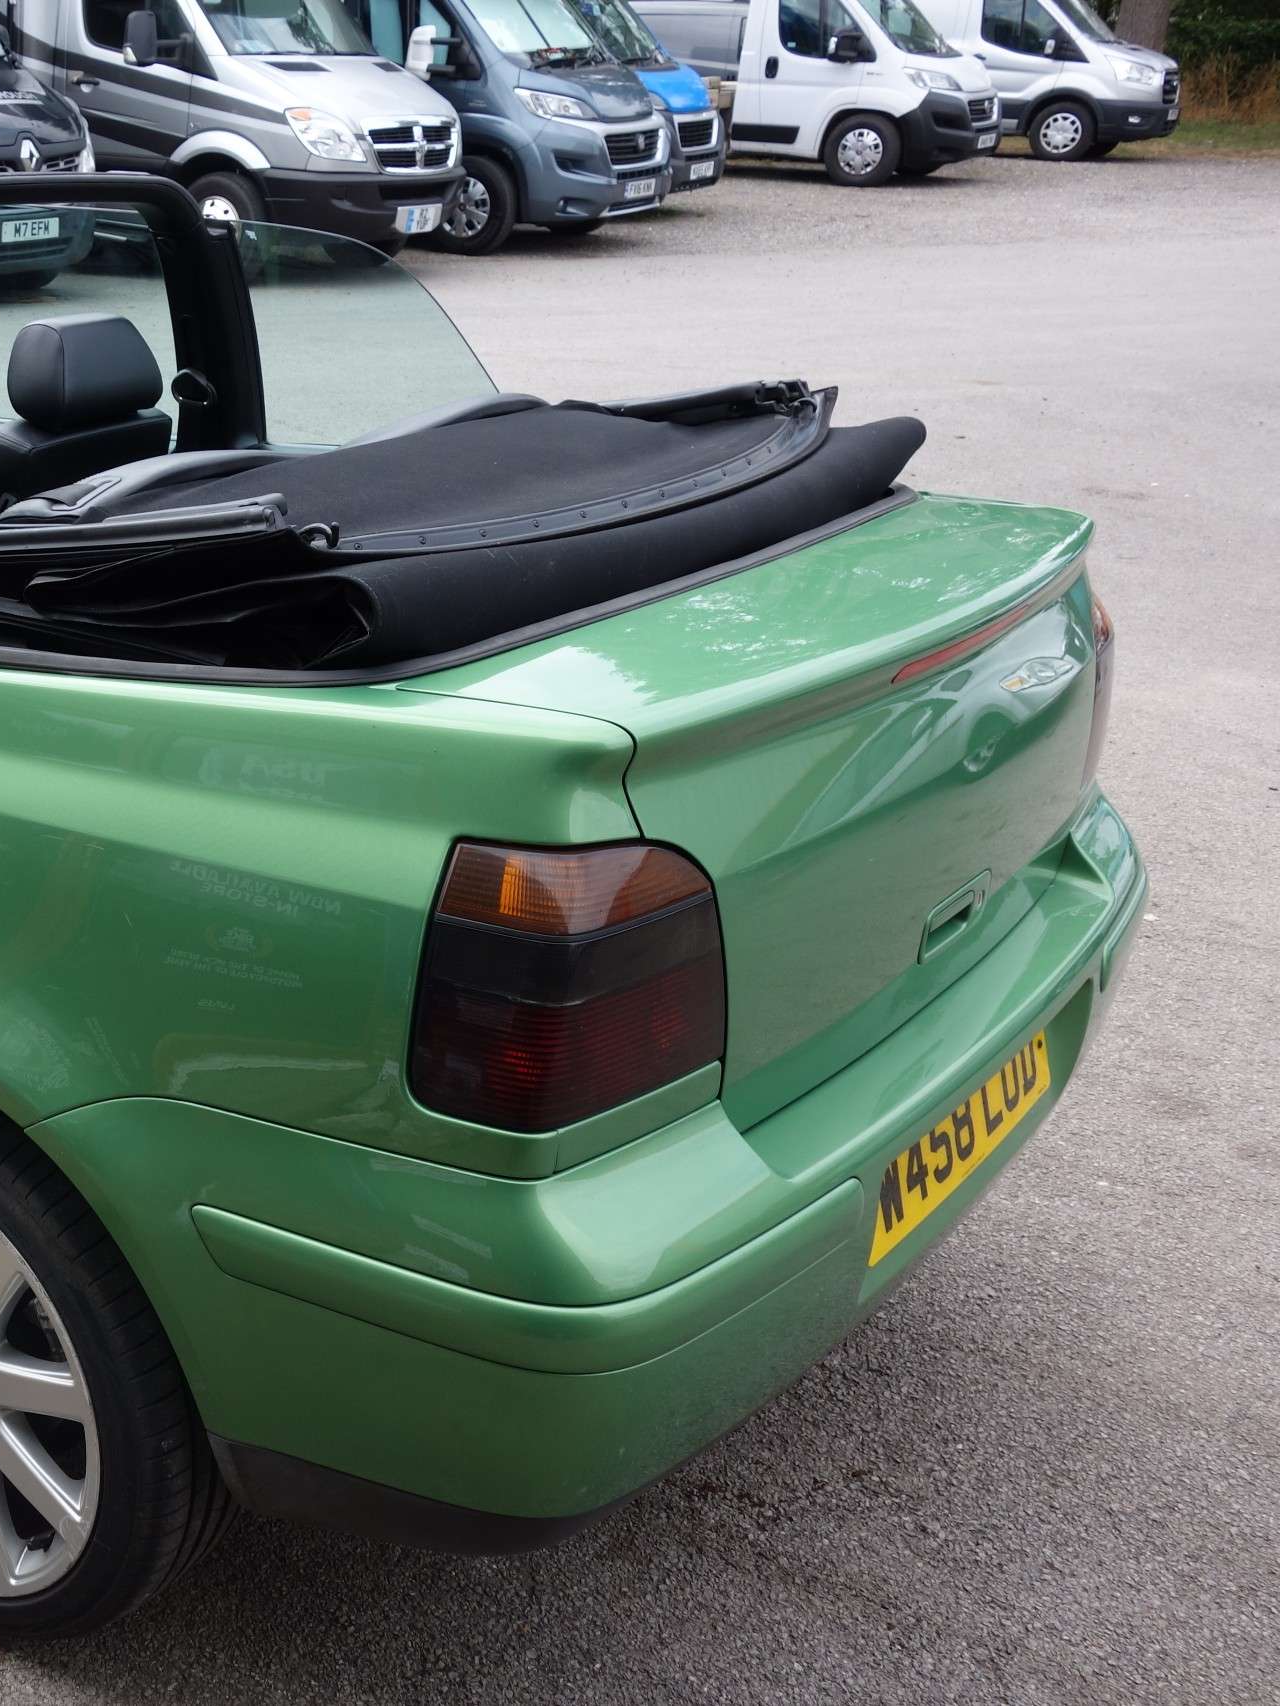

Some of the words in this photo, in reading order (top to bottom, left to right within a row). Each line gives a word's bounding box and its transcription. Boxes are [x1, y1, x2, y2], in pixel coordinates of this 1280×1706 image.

[14, 222, 29, 238] M7
[31, 220, 50, 236] EFM
[879, 1097, 975, 1234] W458
